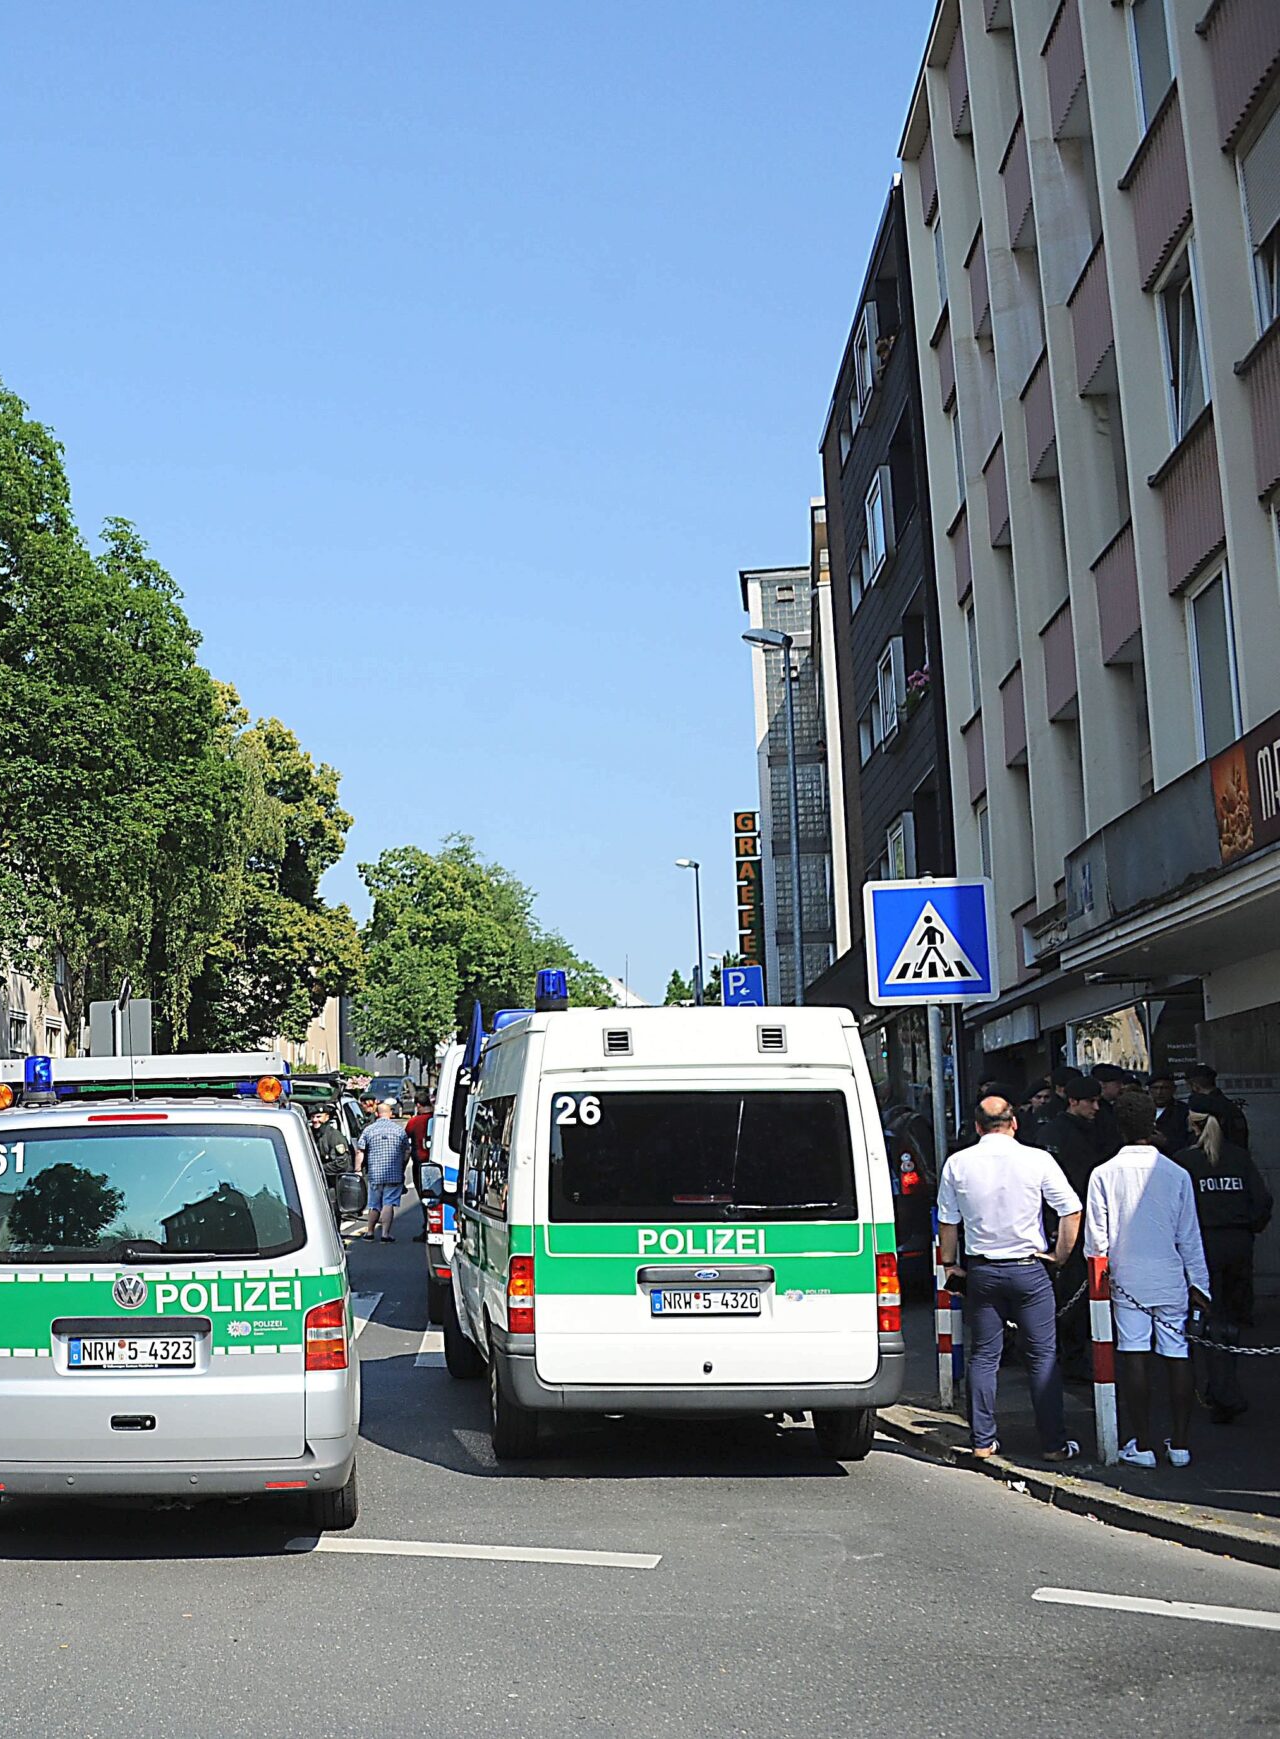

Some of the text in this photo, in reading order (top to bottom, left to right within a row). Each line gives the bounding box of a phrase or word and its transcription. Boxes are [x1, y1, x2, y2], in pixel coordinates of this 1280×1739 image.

[735, 812, 759, 967] GRAEFE
[728, 971, 746, 996] P
[556, 1096, 601, 1125] 26
[1199, 1177, 1243, 1192] POLIZEI
[638, 1229, 765, 1254] POLIZEI
[155, 1281, 302, 1313] POLIZEI
[663, 1292, 692, 1309] NRW
[703, 1292, 758, 1309] 5-4320
[253, 1320, 283, 1328] POLIZEI
[82, 1341, 116, 1361] NRW
[127, 1340, 193, 1360] 5-4323
